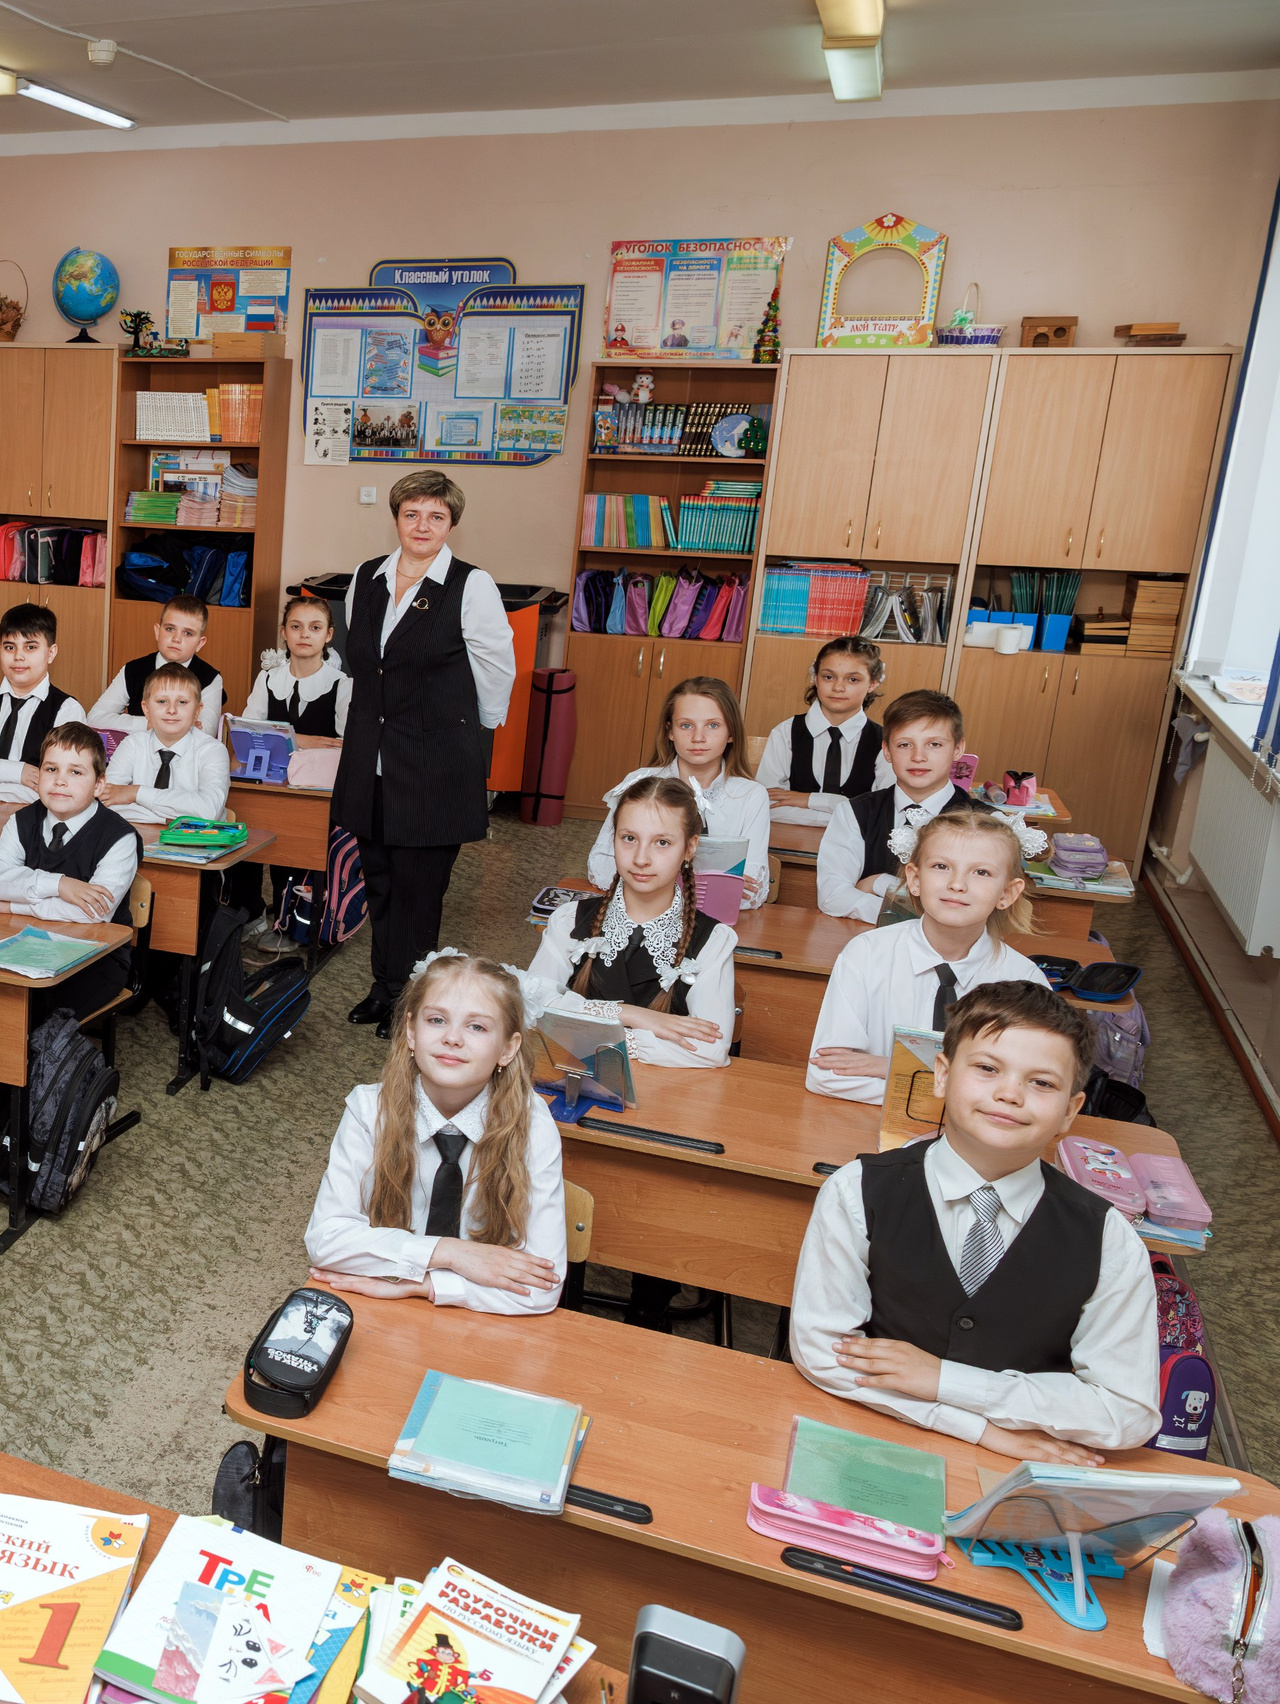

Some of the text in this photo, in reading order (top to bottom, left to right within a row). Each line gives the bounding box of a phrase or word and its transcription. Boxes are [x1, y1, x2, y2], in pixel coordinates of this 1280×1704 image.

[175, 250, 284, 258] ГОСУДАРСТВЕННЫЕ СИМВОЛЫ
[625, 240, 777, 254] УГОЛОК БЕЗОПАСНОСТИ
[182, 259, 273, 267] РОССИЙСКОЙ ФЕДЕРАЦИИ
[394, 268, 491, 286] Классный уголок
[850, 321, 869, 333] МОЙ
[474, 1435, 509, 1448] Тетрадь
[444, 1580, 560, 1643] ПОУРОЧНЫЕ
[438, 1589, 554, 1653] РАЗРАБОТКИ
[19, 1602, 81, 1670] 1
[442, 1604, 457, 1617] ПО
[457, 1611, 505, 1640] РУССКОМУ
[506, 1637, 538, 1655] ЯЗЫКУ
